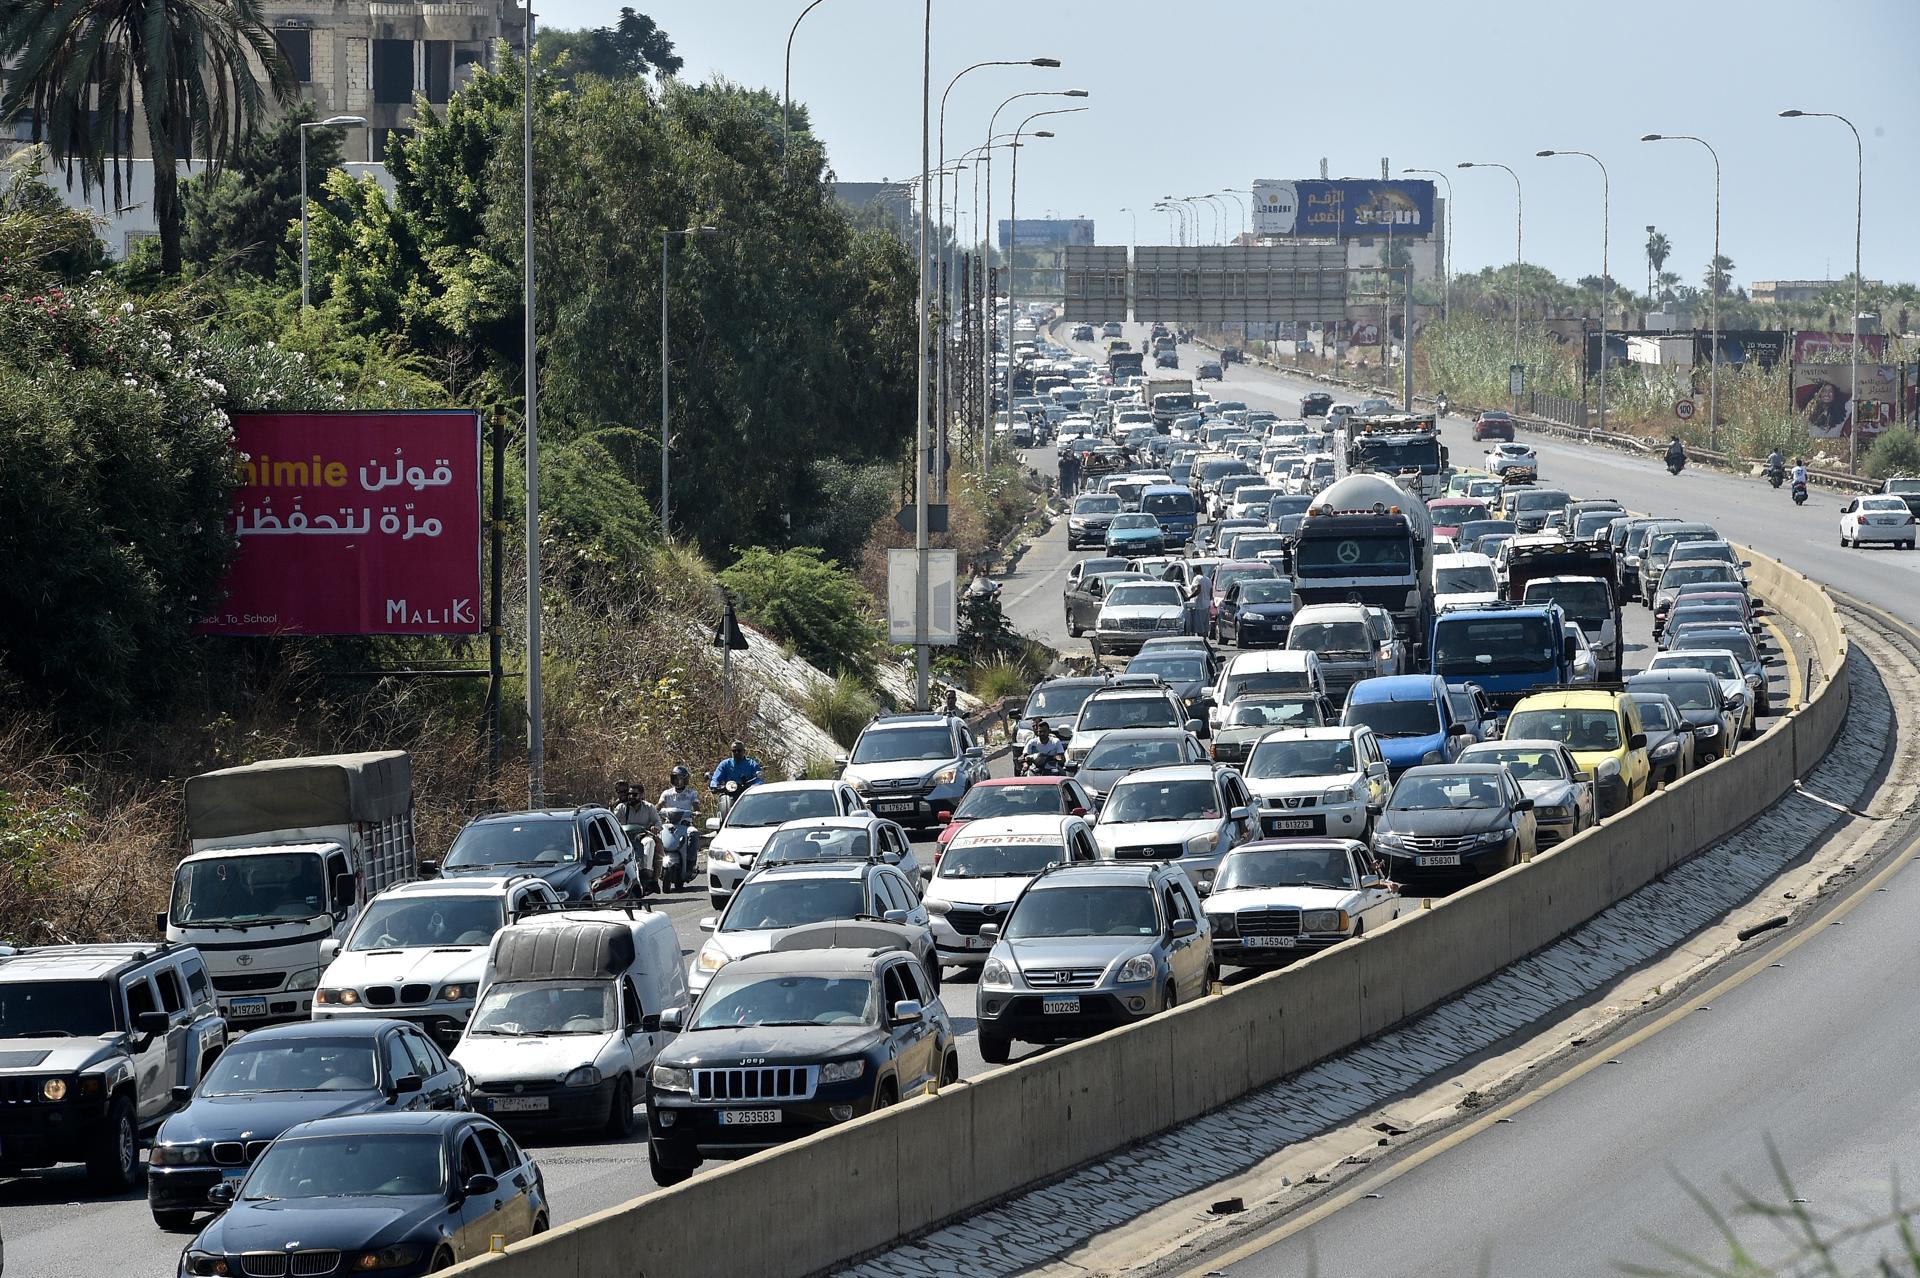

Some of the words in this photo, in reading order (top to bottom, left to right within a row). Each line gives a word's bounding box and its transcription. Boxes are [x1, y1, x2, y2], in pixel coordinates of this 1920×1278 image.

[1680, 404, 1691, 414] 100
[973, 837, 1003, 845] Pro
[1421, 857, 1427, 865] B
[1250, 937, 1256, 946] B
[1261, 937, 1289, 946] 145940
[726, 1112, 733, 1123] S
[738, 1111, 776, 1123] 253583
